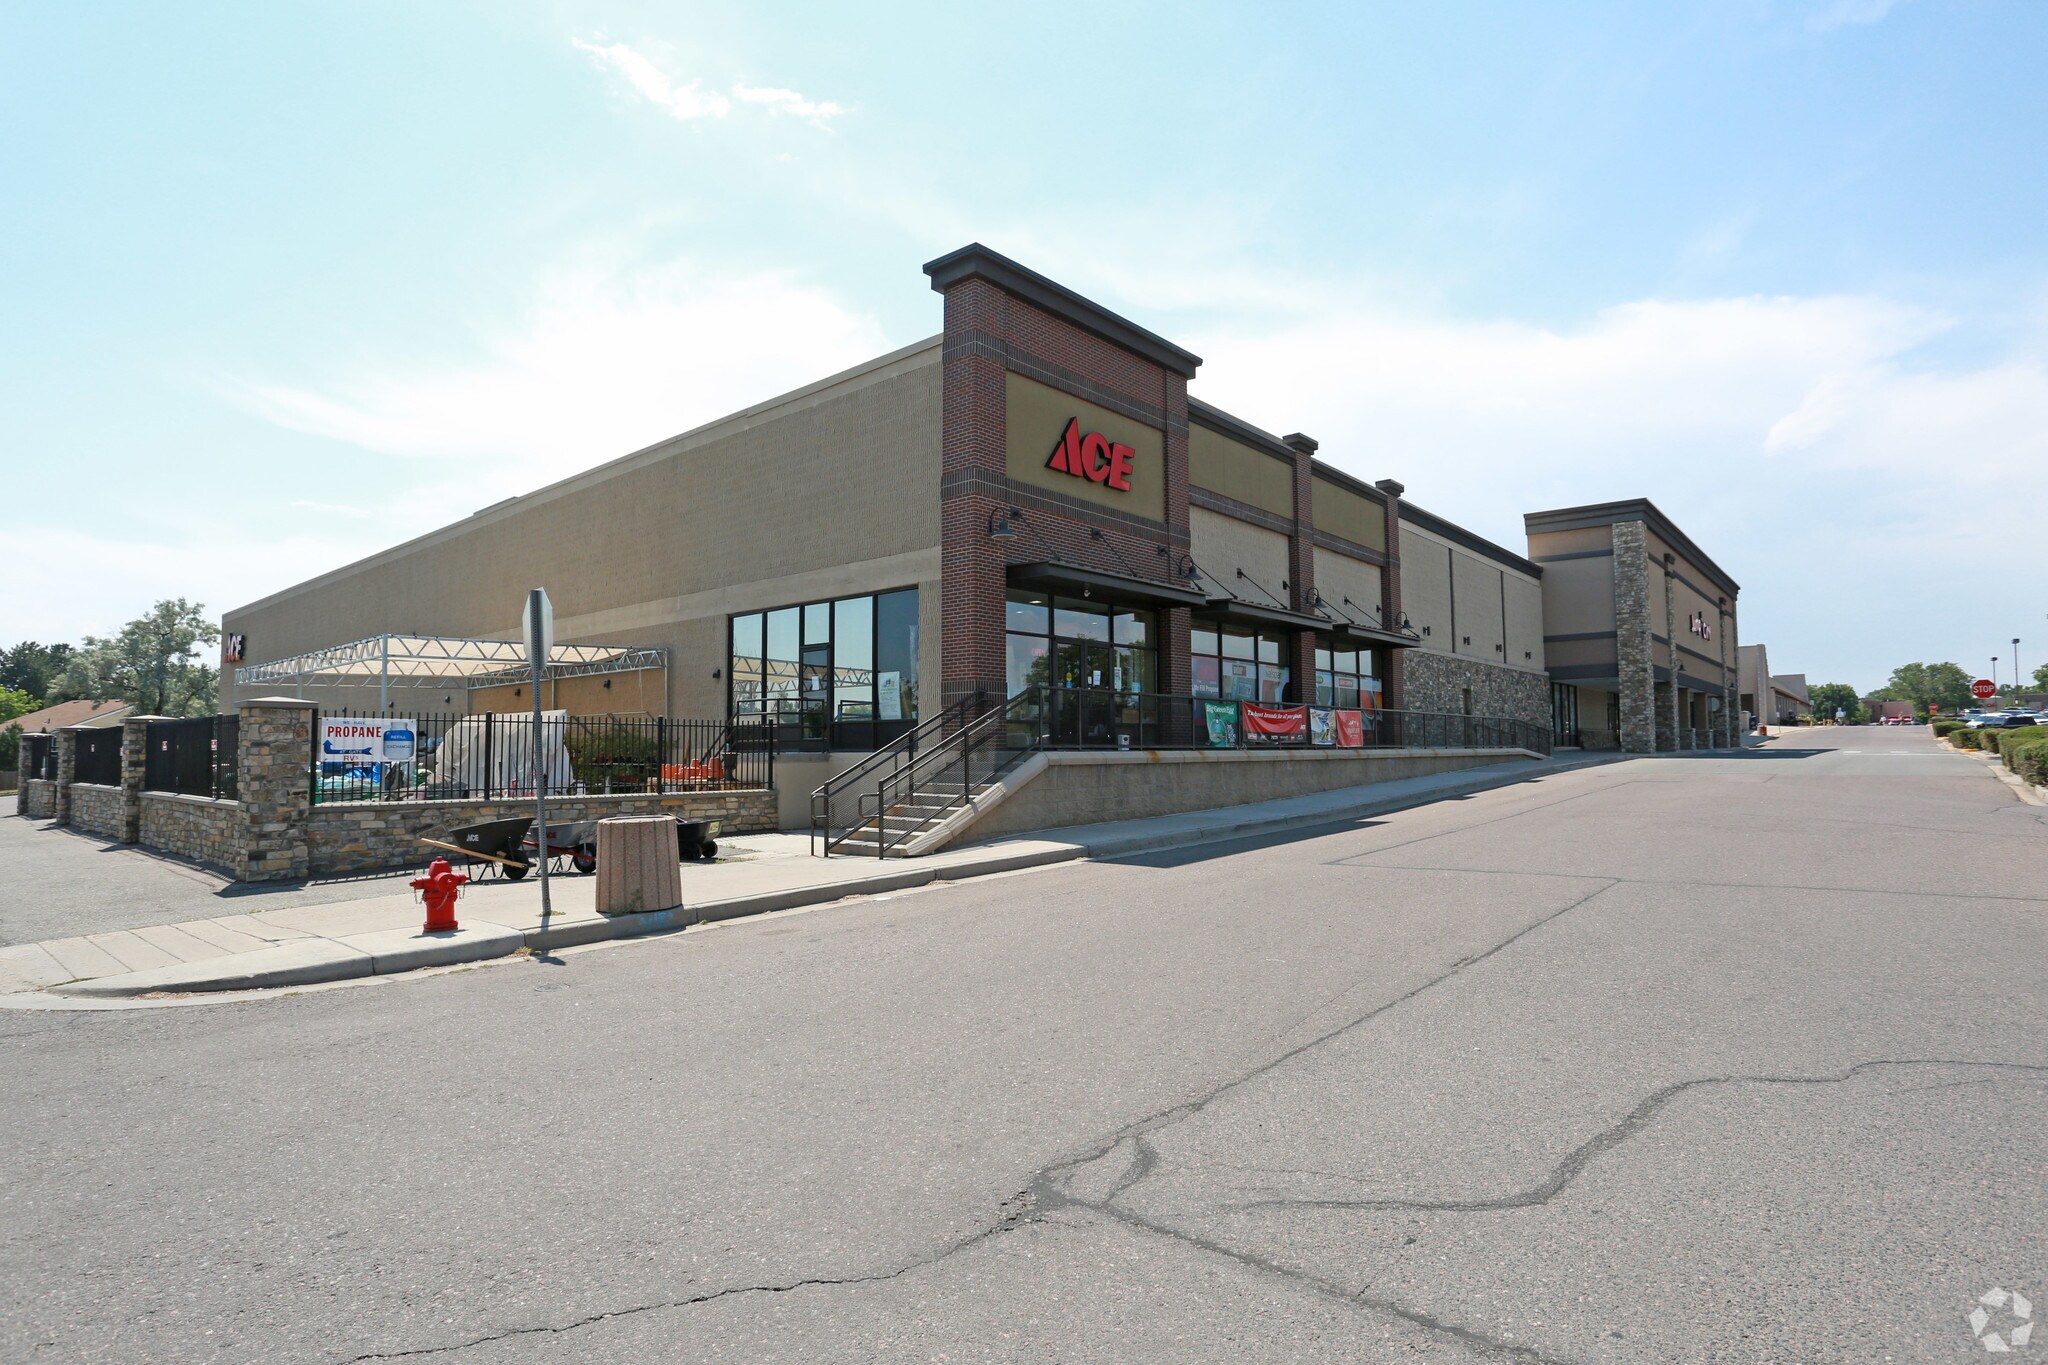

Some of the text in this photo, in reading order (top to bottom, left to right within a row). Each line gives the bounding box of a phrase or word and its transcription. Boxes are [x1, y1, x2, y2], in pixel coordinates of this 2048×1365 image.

[1045, 416, 1136, 492] ACE
[1973, 685, 1995, 693] STOP
[327, 726, 382, 738] PROPANE
[466, 833, 480, 841] ACE
